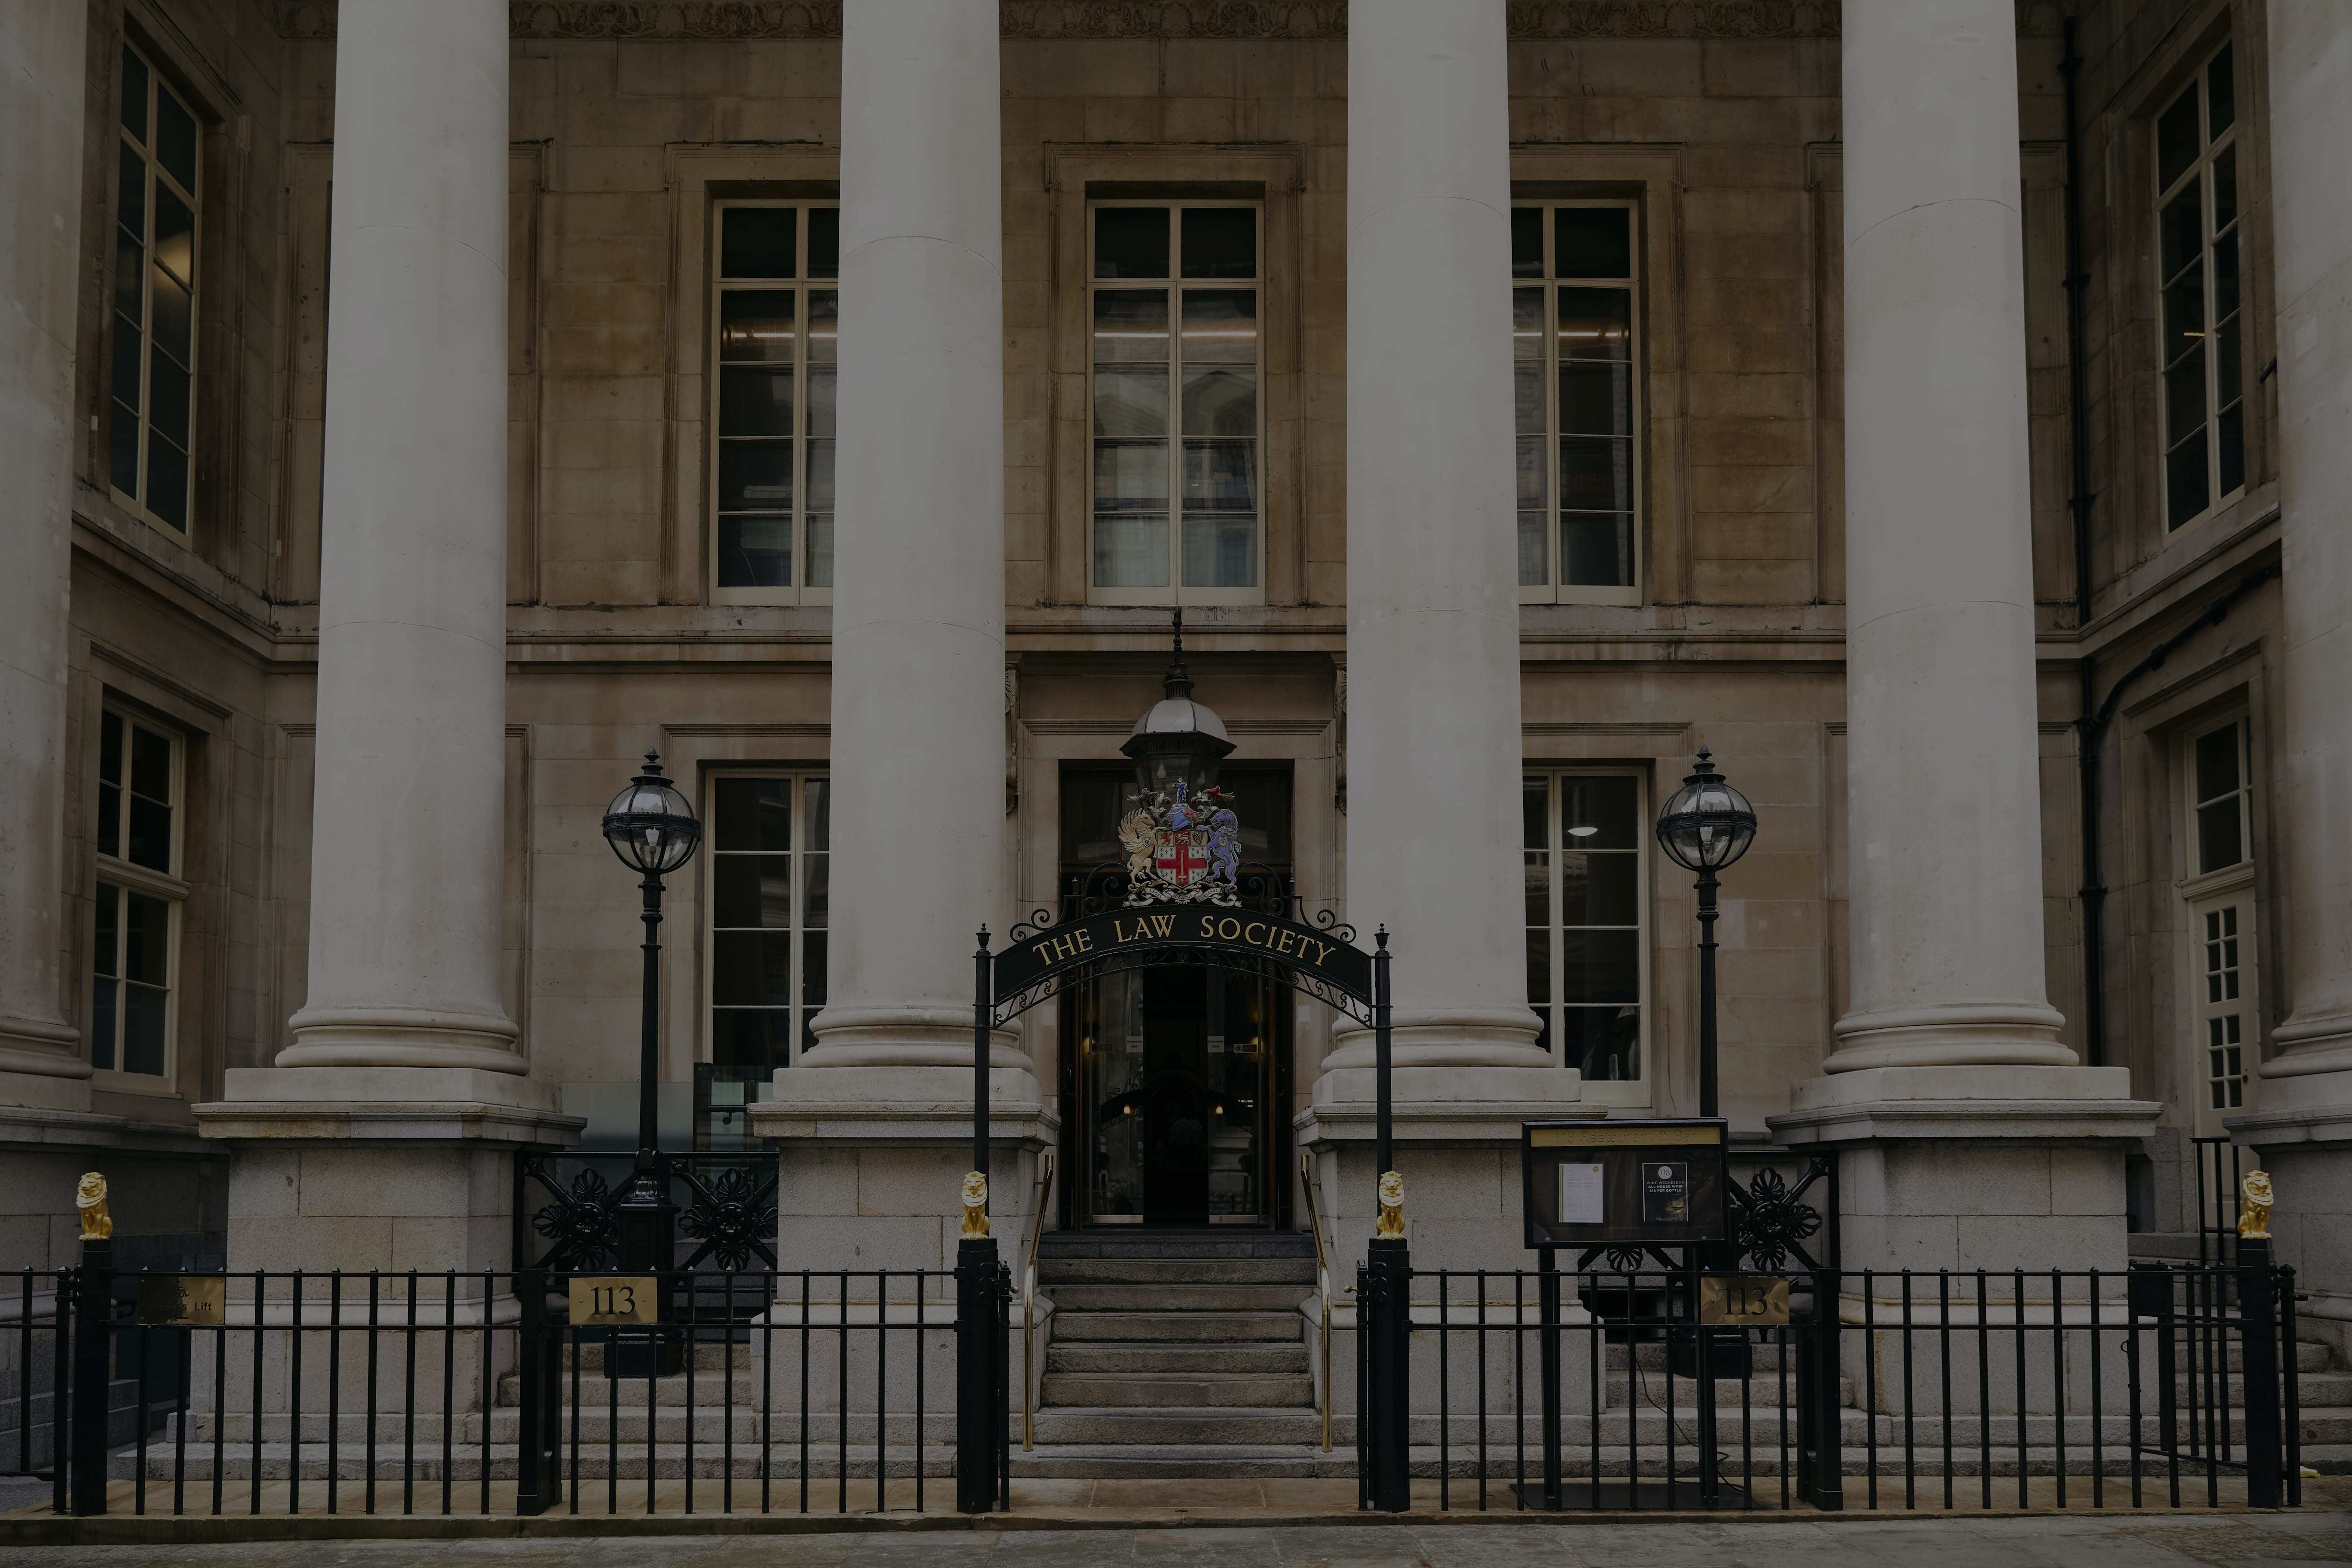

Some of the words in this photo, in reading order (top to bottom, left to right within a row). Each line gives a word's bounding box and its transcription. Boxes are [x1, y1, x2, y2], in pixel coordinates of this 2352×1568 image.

[1149, 889, 1162, 898] LEGES
[1032, 928, 1093, 965] THE
[1114, 915, 1176, 943] LAW
[1200, 915, 1336, 966] SOCIETY
[1554, 1132, 1575, 1143] 113
[1580, 1131, 1653, 1142] Restaurant
[1658, 1130, 1667, 1141] &
[1674, 1130, 1696, 1141] Bar
[195, 1302, 212, 1310] Lift
[591, 1286, 635, 1315] 113
[1723, 1287, 1768, 1315] 113
